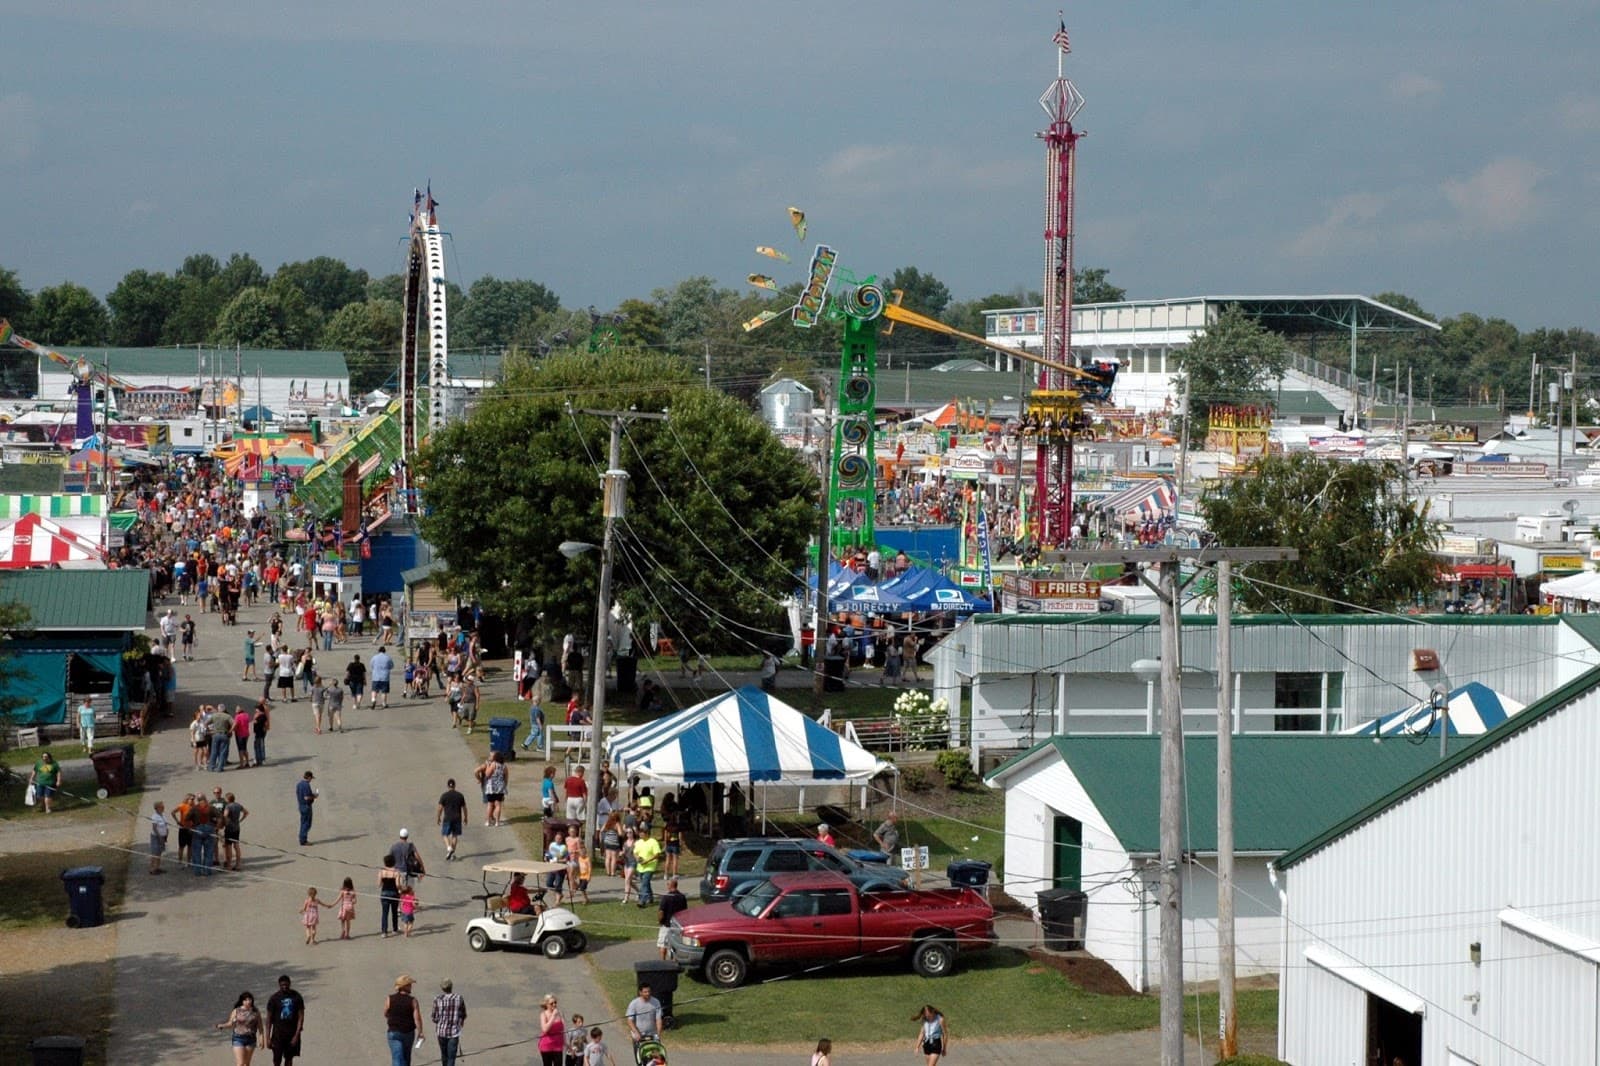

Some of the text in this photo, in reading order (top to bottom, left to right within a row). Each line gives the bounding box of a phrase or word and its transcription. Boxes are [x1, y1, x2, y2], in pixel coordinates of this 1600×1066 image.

[1048, 582, 1087, 594] FRIES
[851, 602, 899, 612] DIRECTV
[943, 602, 974, 611] DIRECTV
